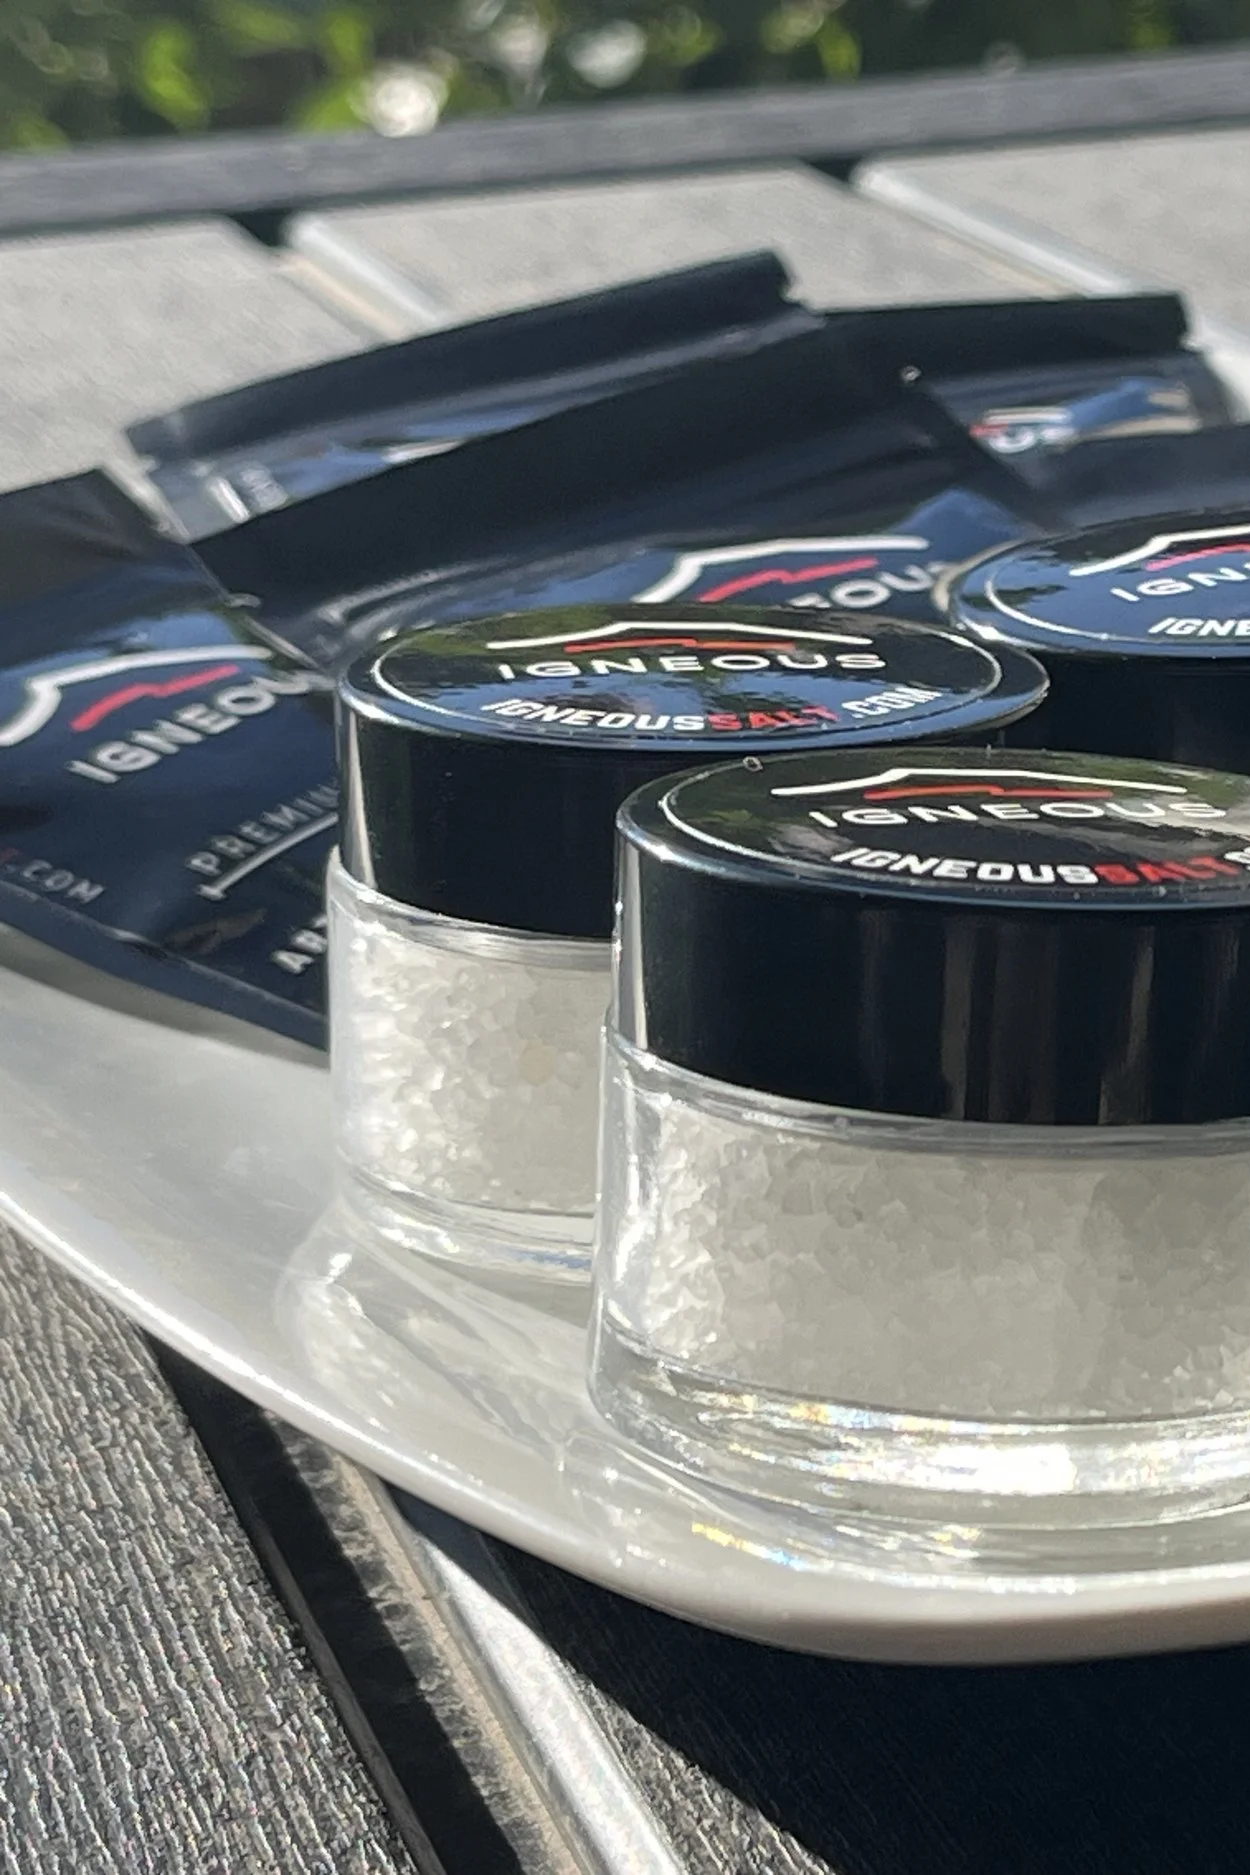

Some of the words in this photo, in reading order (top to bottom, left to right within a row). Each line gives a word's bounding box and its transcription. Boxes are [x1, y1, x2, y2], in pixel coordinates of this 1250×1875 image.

[499, 652, 886, 680] IGNEOUS
[479, 686, 943, 732] IGNEOUSSALT.COM
[809, 802, 1227, 828] IGNEOUS
